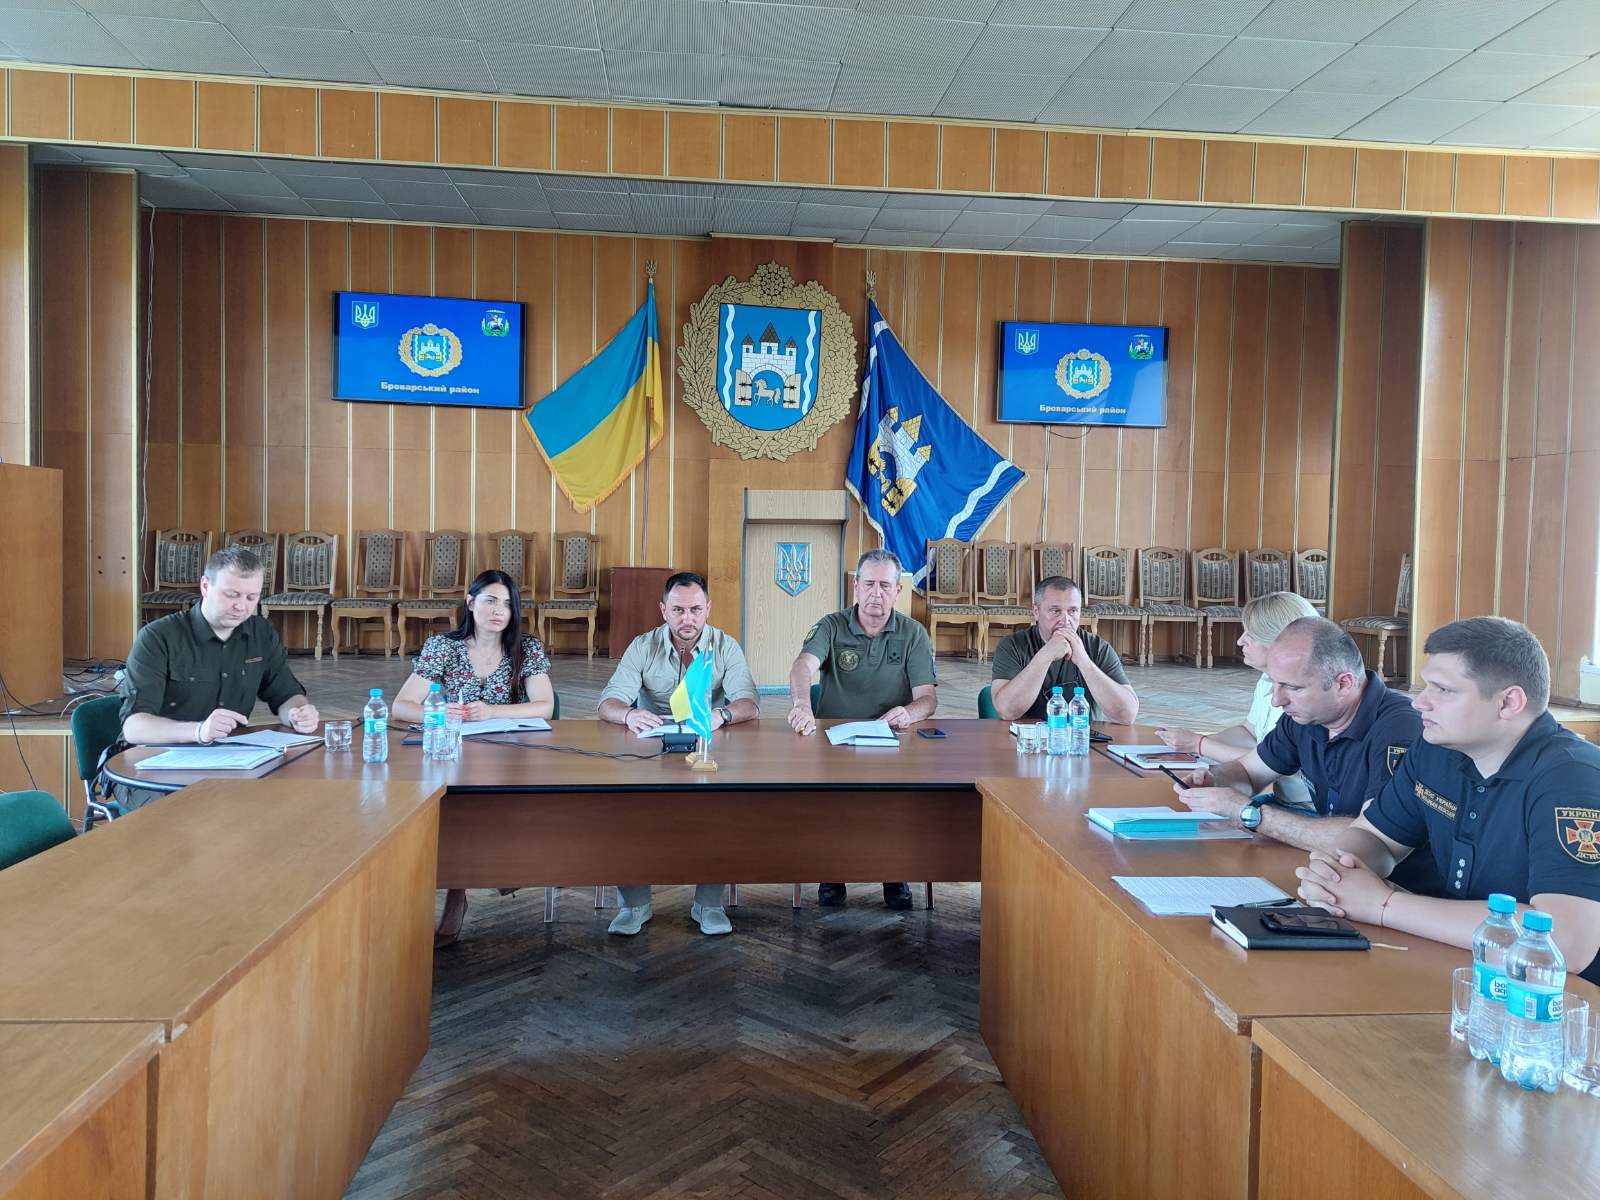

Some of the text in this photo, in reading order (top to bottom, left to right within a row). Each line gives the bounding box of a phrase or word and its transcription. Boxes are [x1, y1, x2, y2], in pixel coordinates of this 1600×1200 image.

[380, 381, 480, 395] Броварський район
[1039, 404, 1127, 415] Броварський район
[1561, 810, 1600, 819] УКРАЇН
